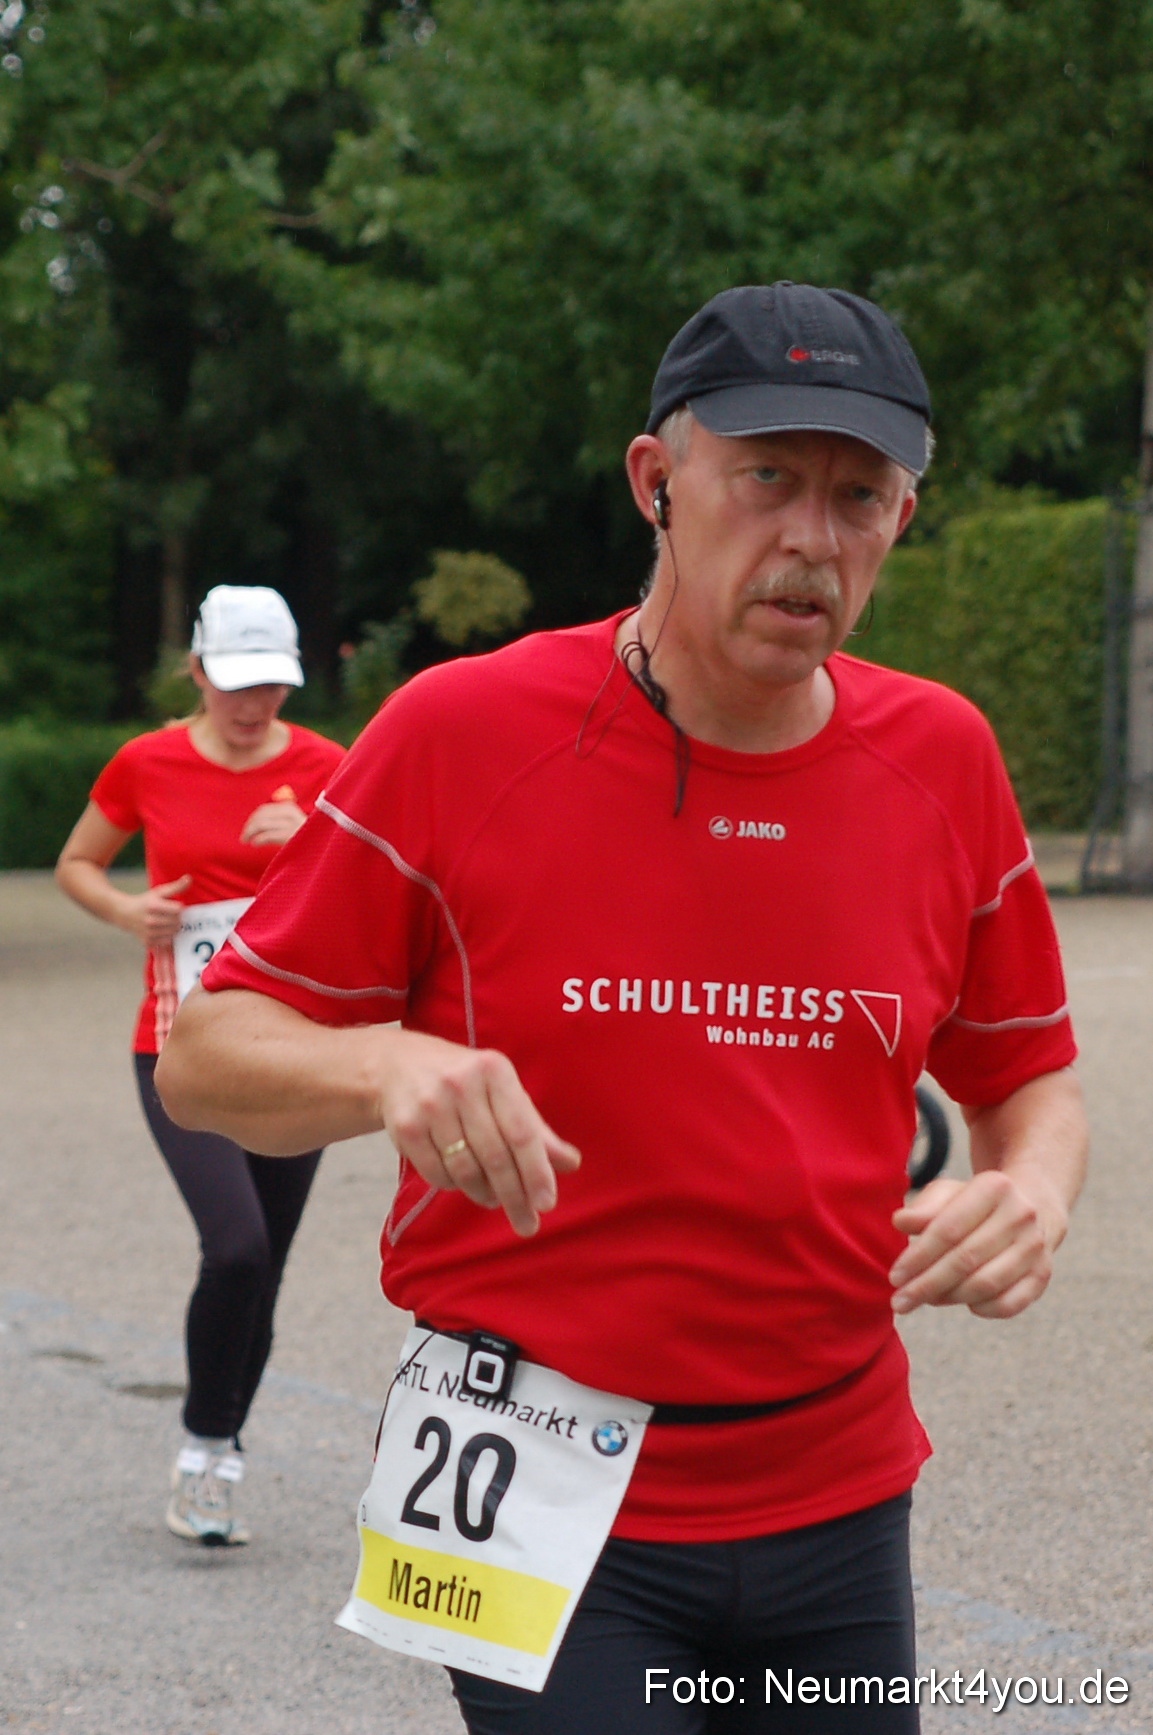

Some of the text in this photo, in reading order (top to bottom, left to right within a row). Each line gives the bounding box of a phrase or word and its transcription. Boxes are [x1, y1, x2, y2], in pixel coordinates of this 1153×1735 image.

[736, 820, 786, 841] JAKO
[562, 977, 845, 1023] SCHULTHEISS
[706, 1025, 835, 1050] Wohnbau AG
[400, 1415, 517, 1543] 20
[388, 1557, 482, 1624] Martin
